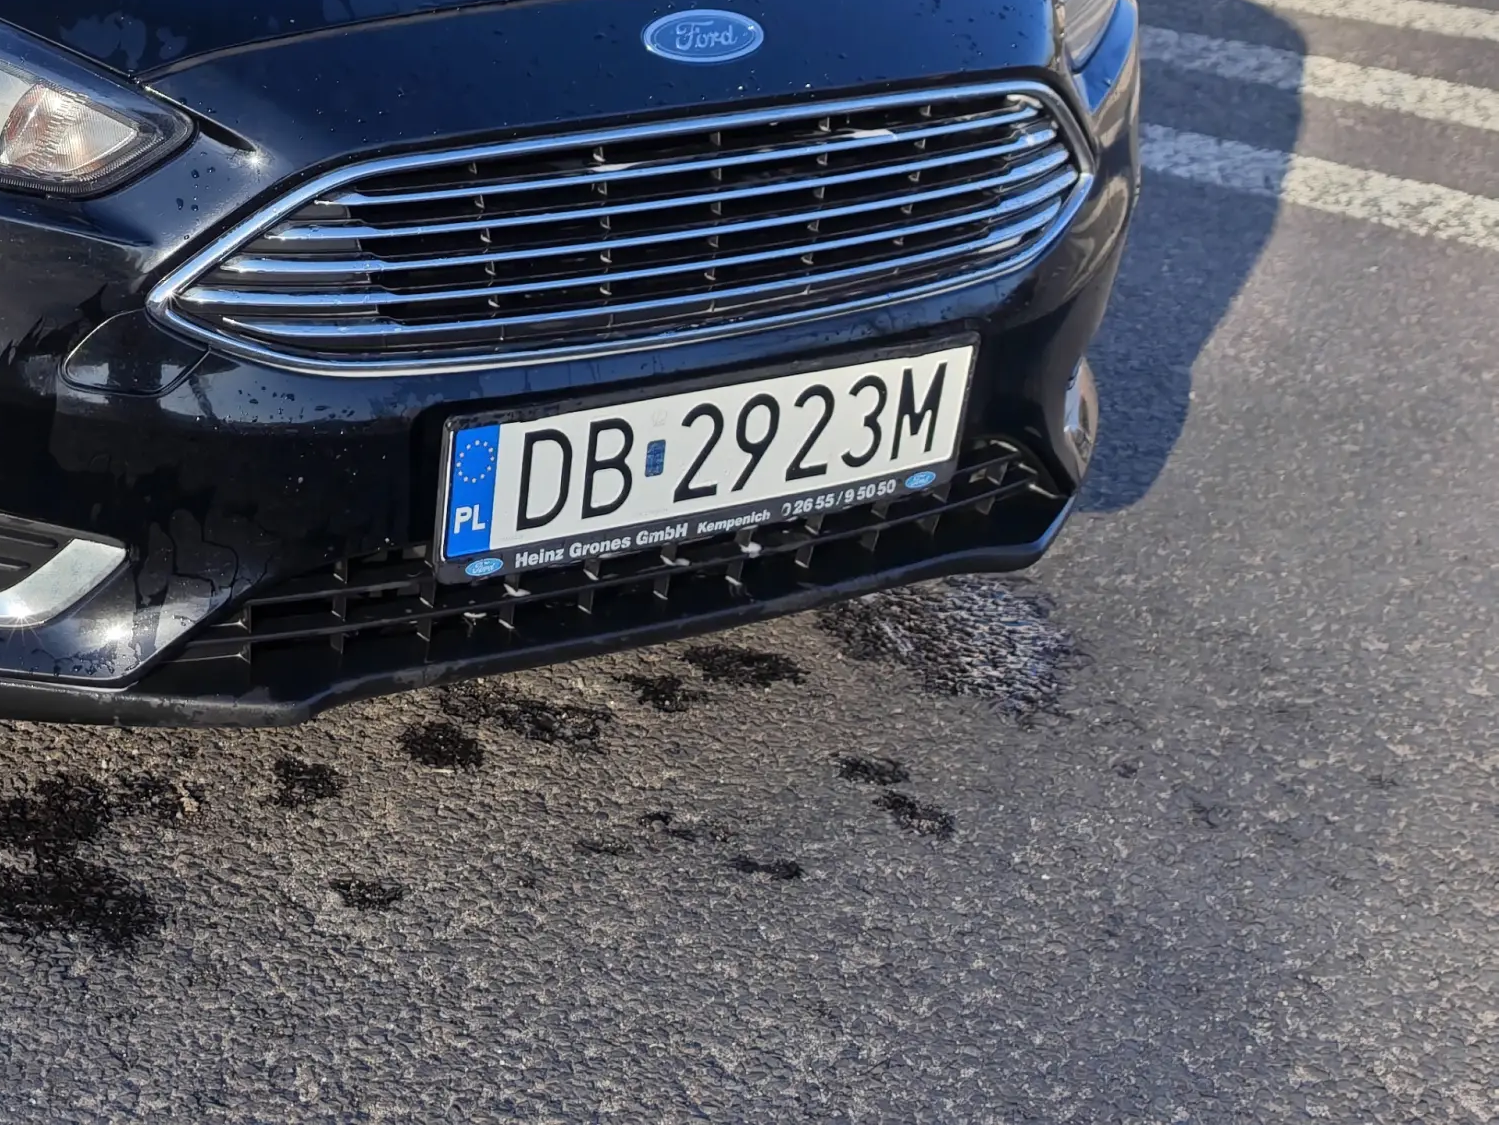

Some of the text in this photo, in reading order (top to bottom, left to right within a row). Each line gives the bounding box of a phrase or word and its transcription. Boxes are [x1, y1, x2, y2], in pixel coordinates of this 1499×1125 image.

[675, 20, 738, 51] Ford
[516, 360, 948, 532] DB 2923M
[454, 506, 486, 535] PL
[515, 547, 564, 569] Heinz
[569, 535, 631, 559] Grones
[636, 523, 688, 547] GmbH
[697, 509, 771, 535] Kempenich
